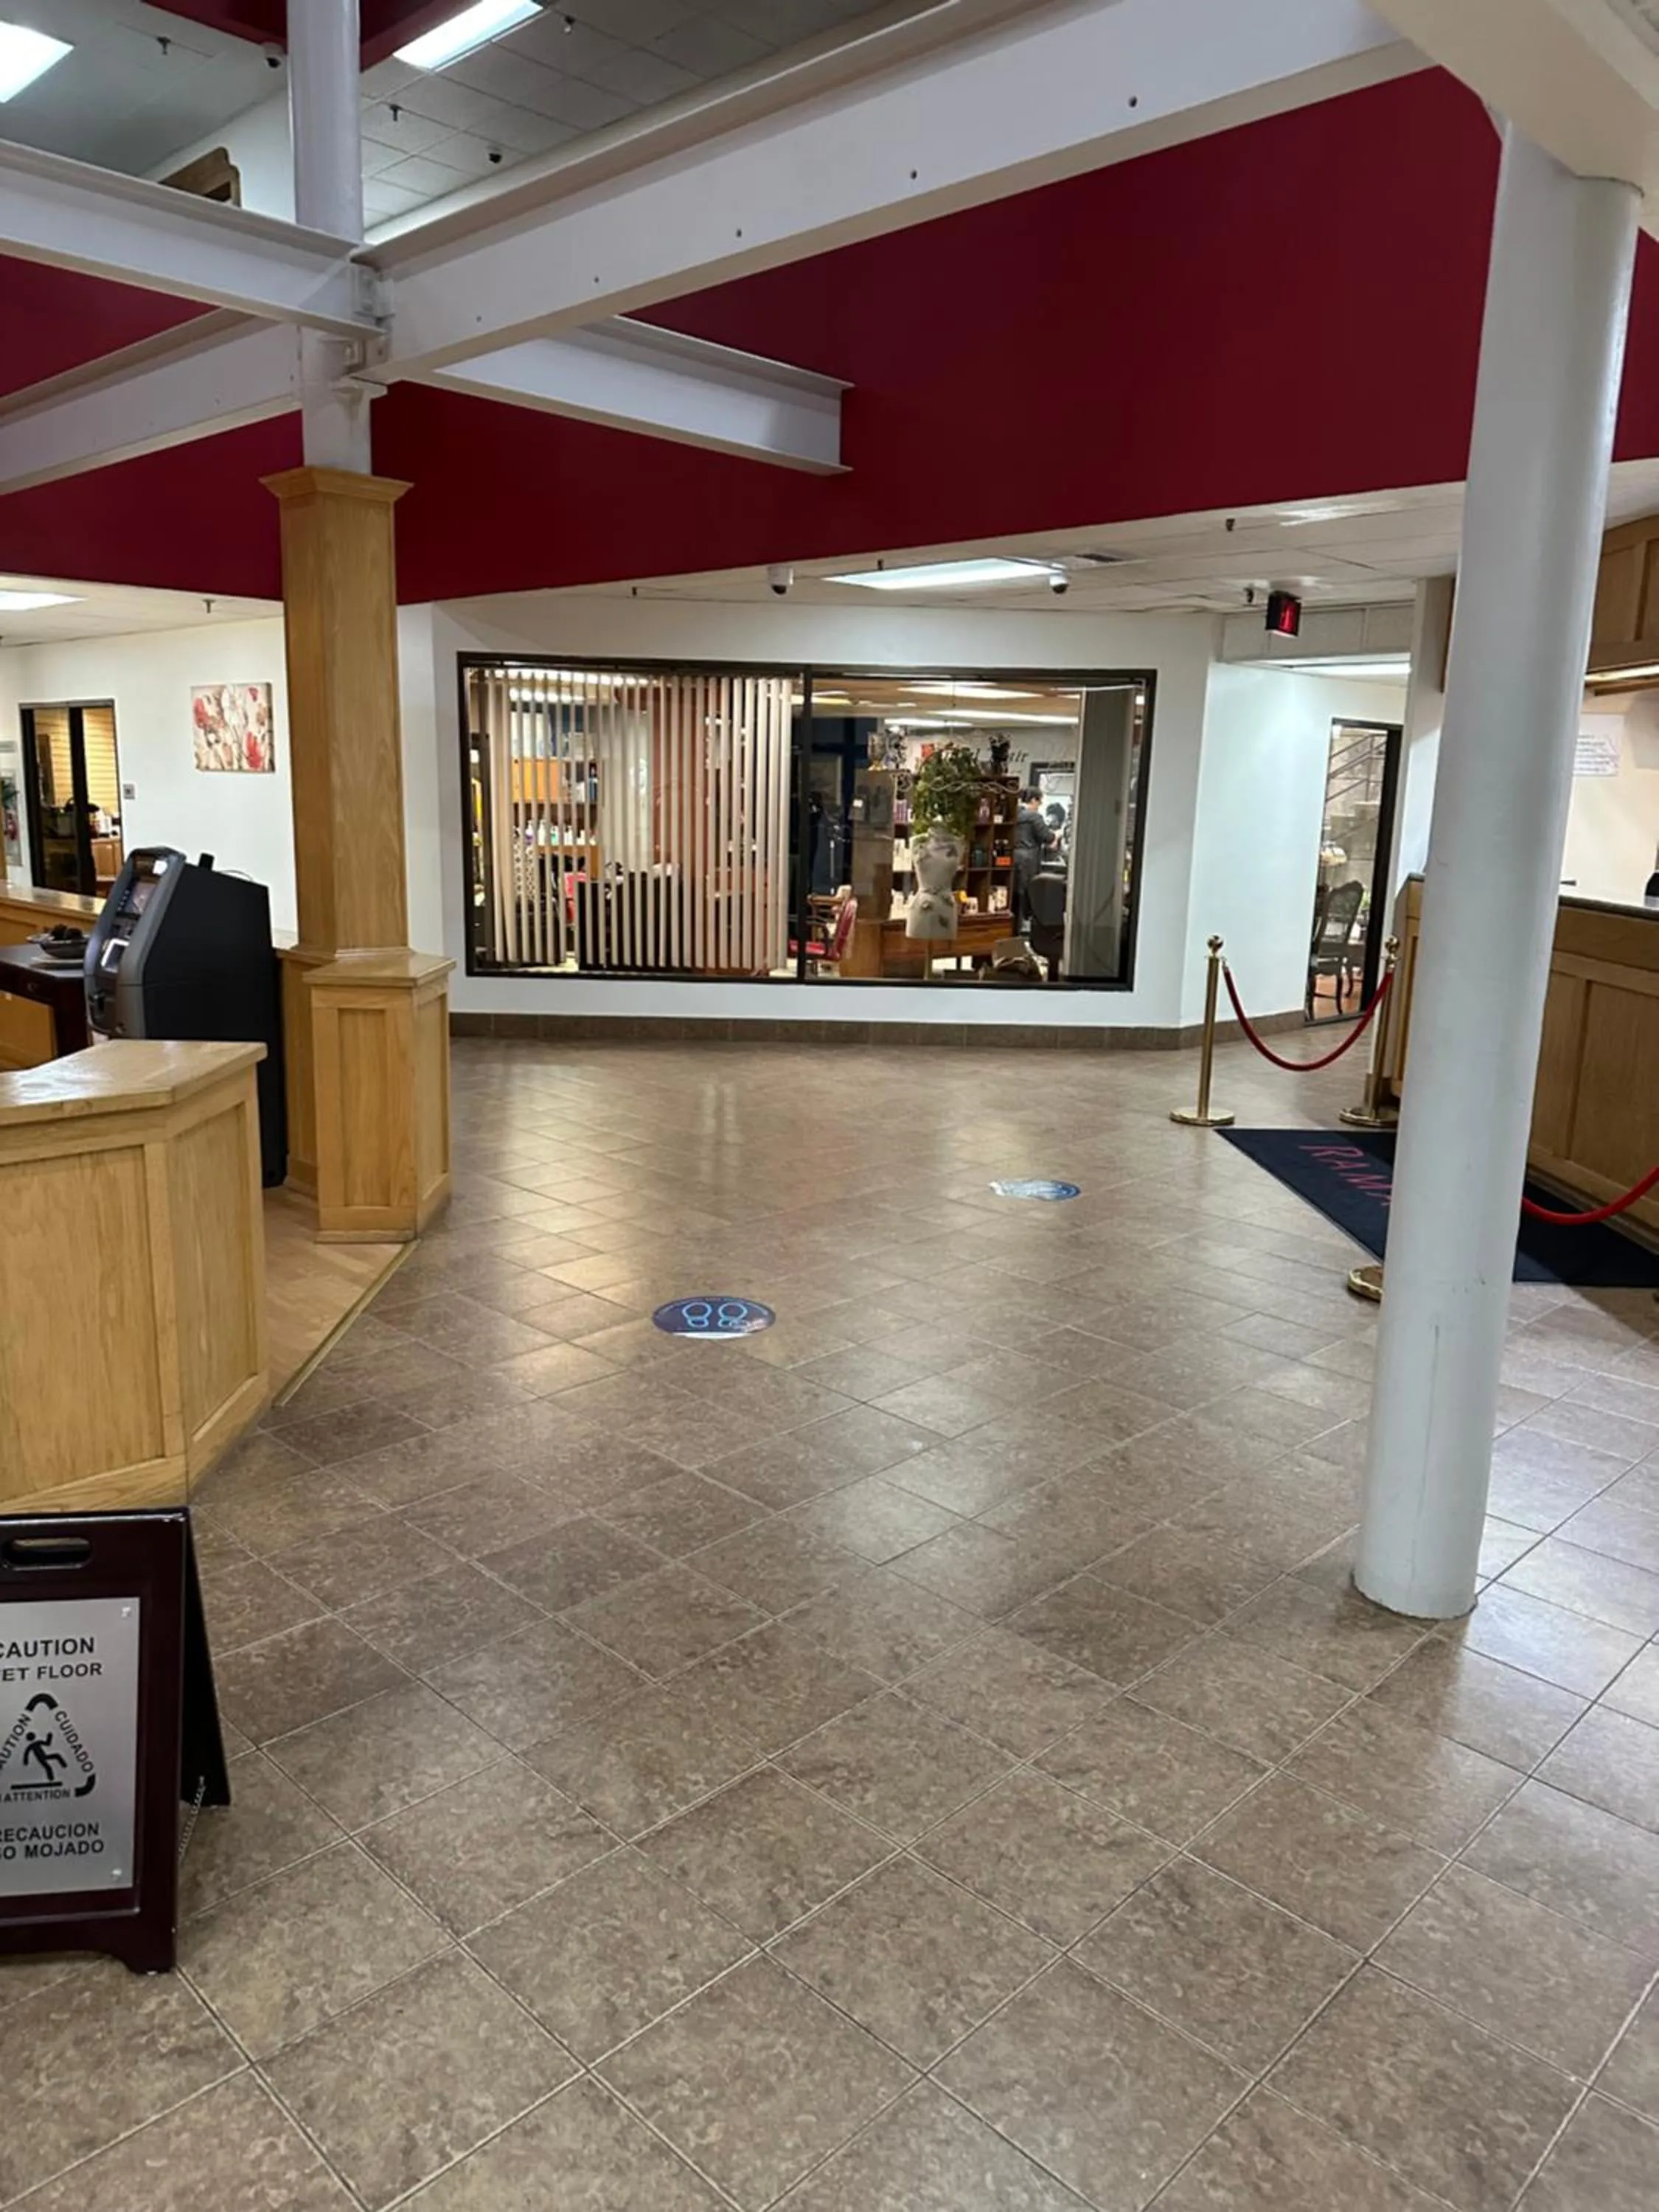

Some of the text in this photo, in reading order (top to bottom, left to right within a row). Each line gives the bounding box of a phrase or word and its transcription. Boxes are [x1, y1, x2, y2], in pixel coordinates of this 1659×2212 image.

[2, 1662, 102, 1682] ET FLOOR
[0, 1713, 31, 1769] UTION
[55, 1711, 94, 1773] CUIDADO
[4, 1788, 71, 1802] ATTENTION
[0, 1823, 100, 1843] ECAUCION
[25, 1839, 104, 1859] MOJADO
